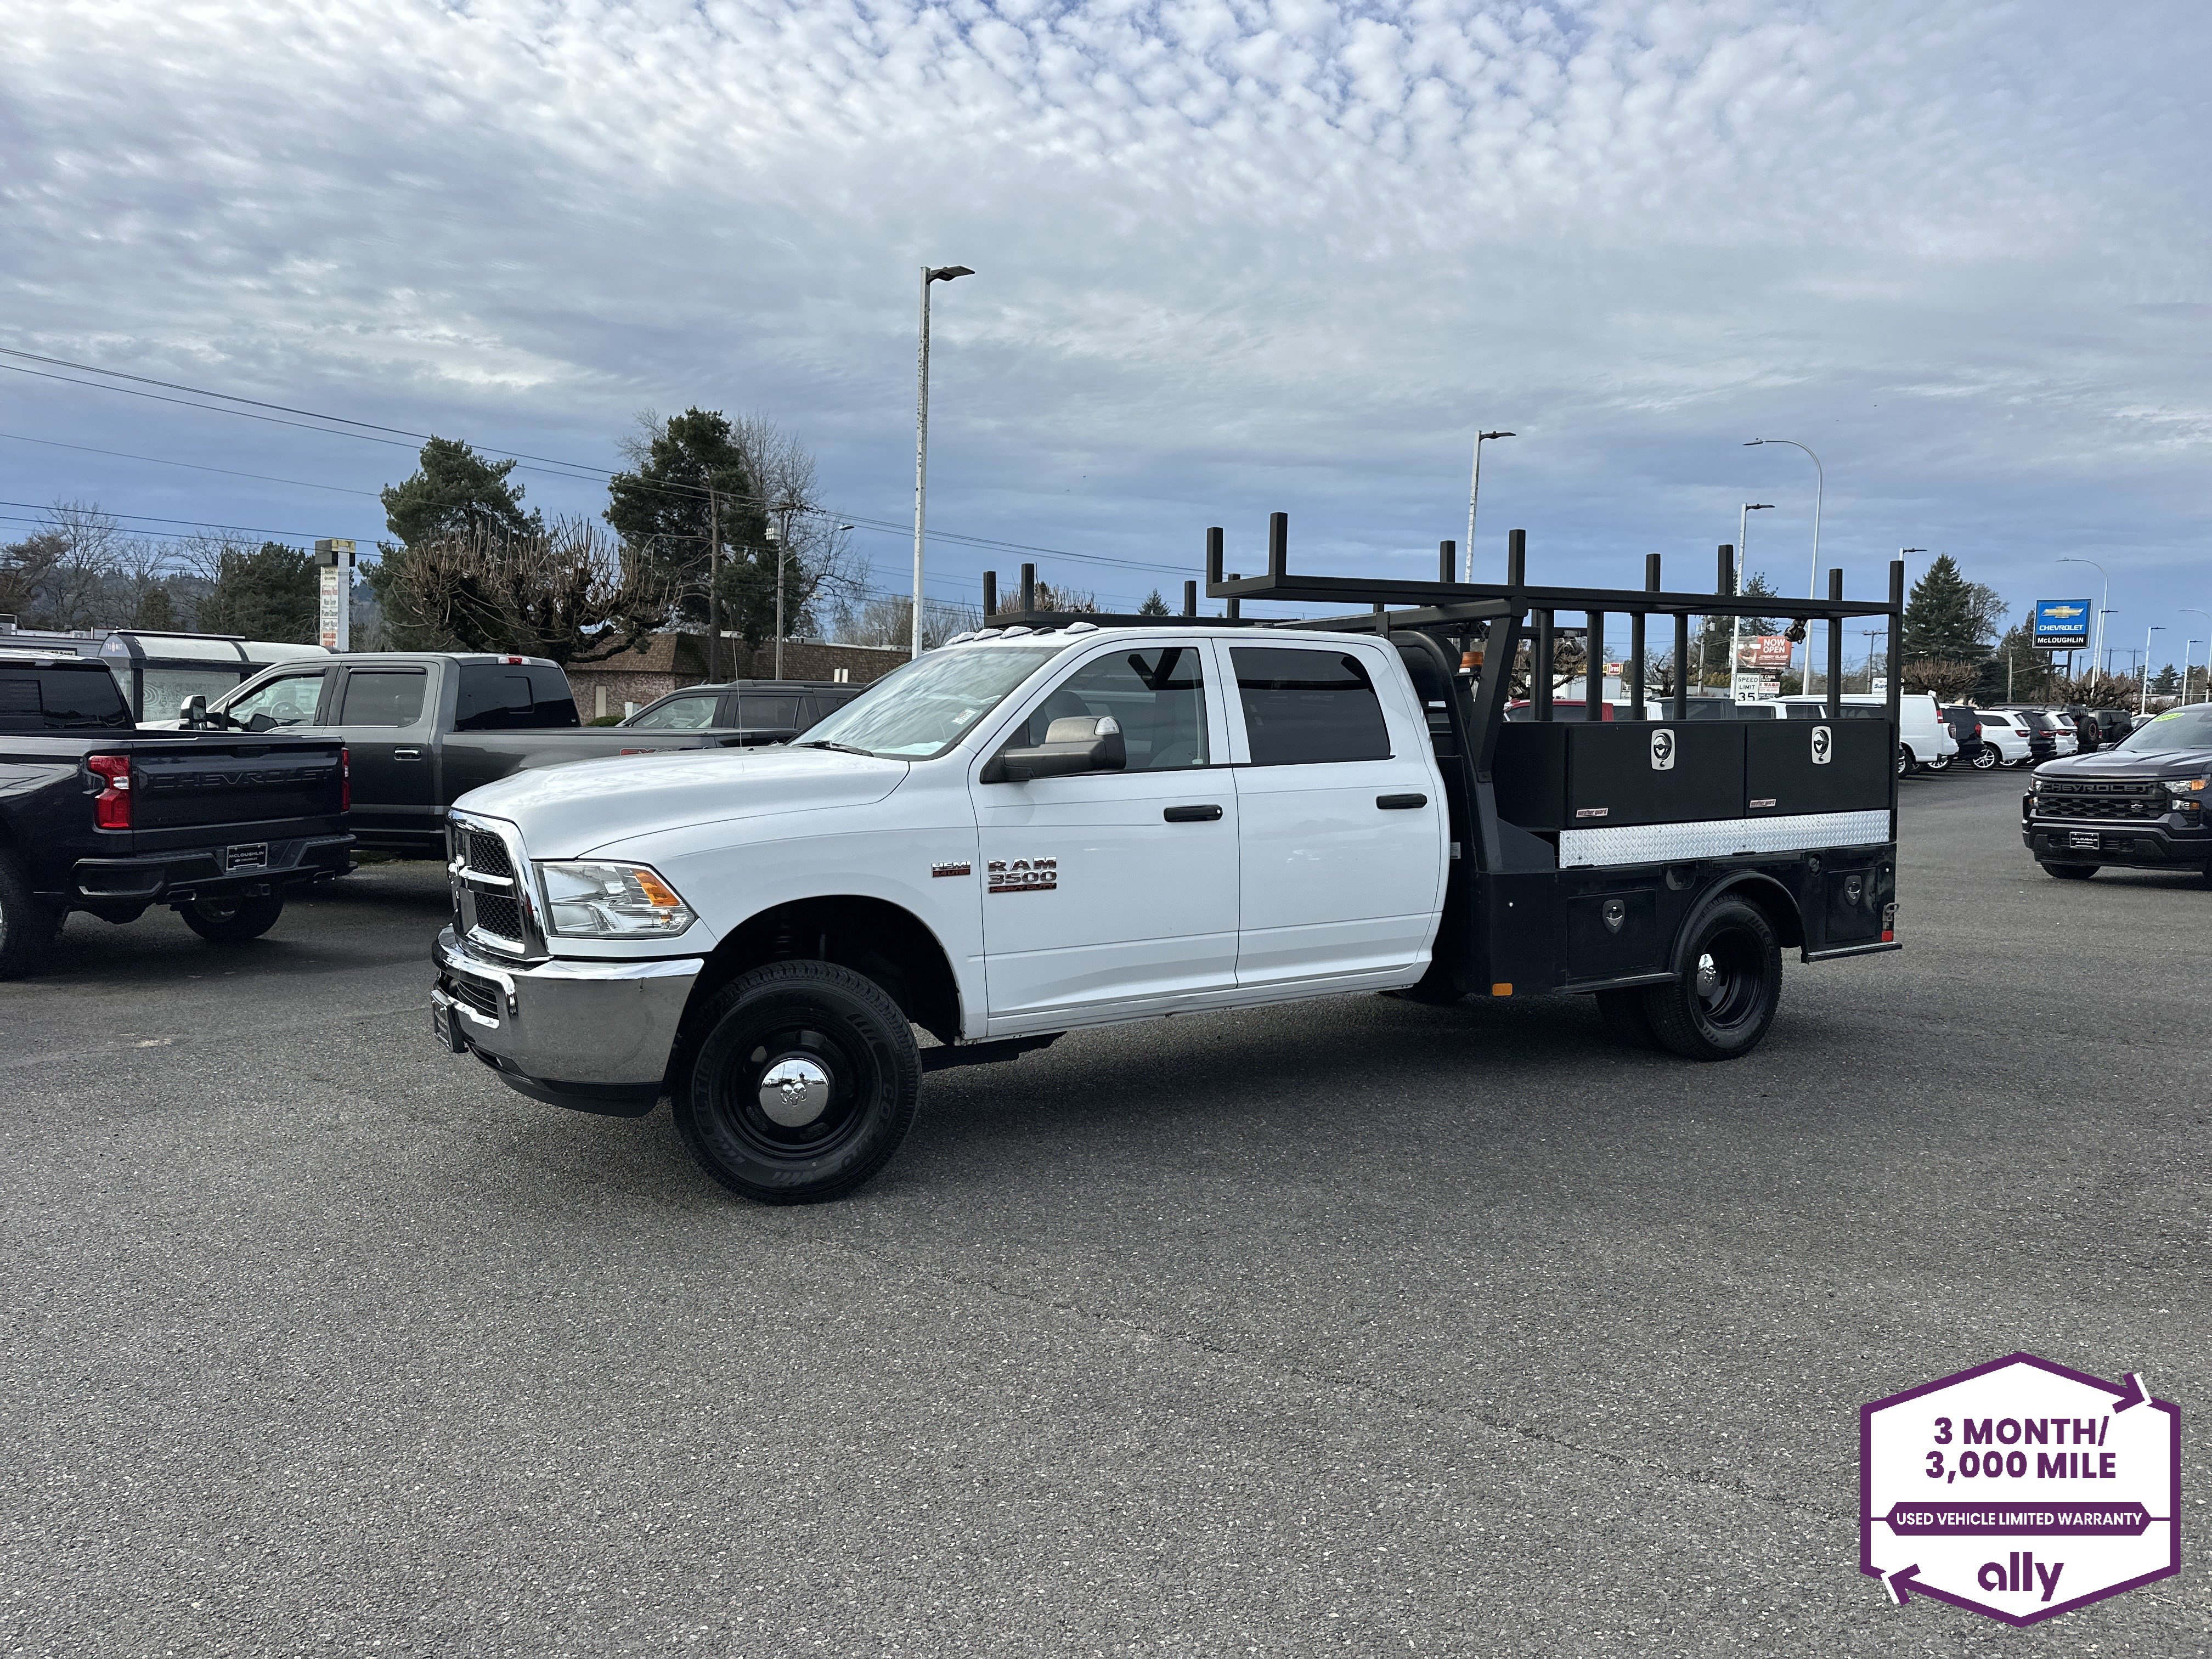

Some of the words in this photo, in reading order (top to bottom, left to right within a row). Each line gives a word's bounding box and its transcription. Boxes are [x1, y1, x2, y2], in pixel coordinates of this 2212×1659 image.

[1764, 638, 1786, 646] NOW
[1737, 692, 1755, 701] 35
[151, 769, 334, 789] CHEVROLET
[2042, 783, 2151, 792] CHEVROLET
[932, 861, 970, 871] HEMI
[988, 856, 1057, 872] RAM
[988, 869, 1057, 884] 3500
